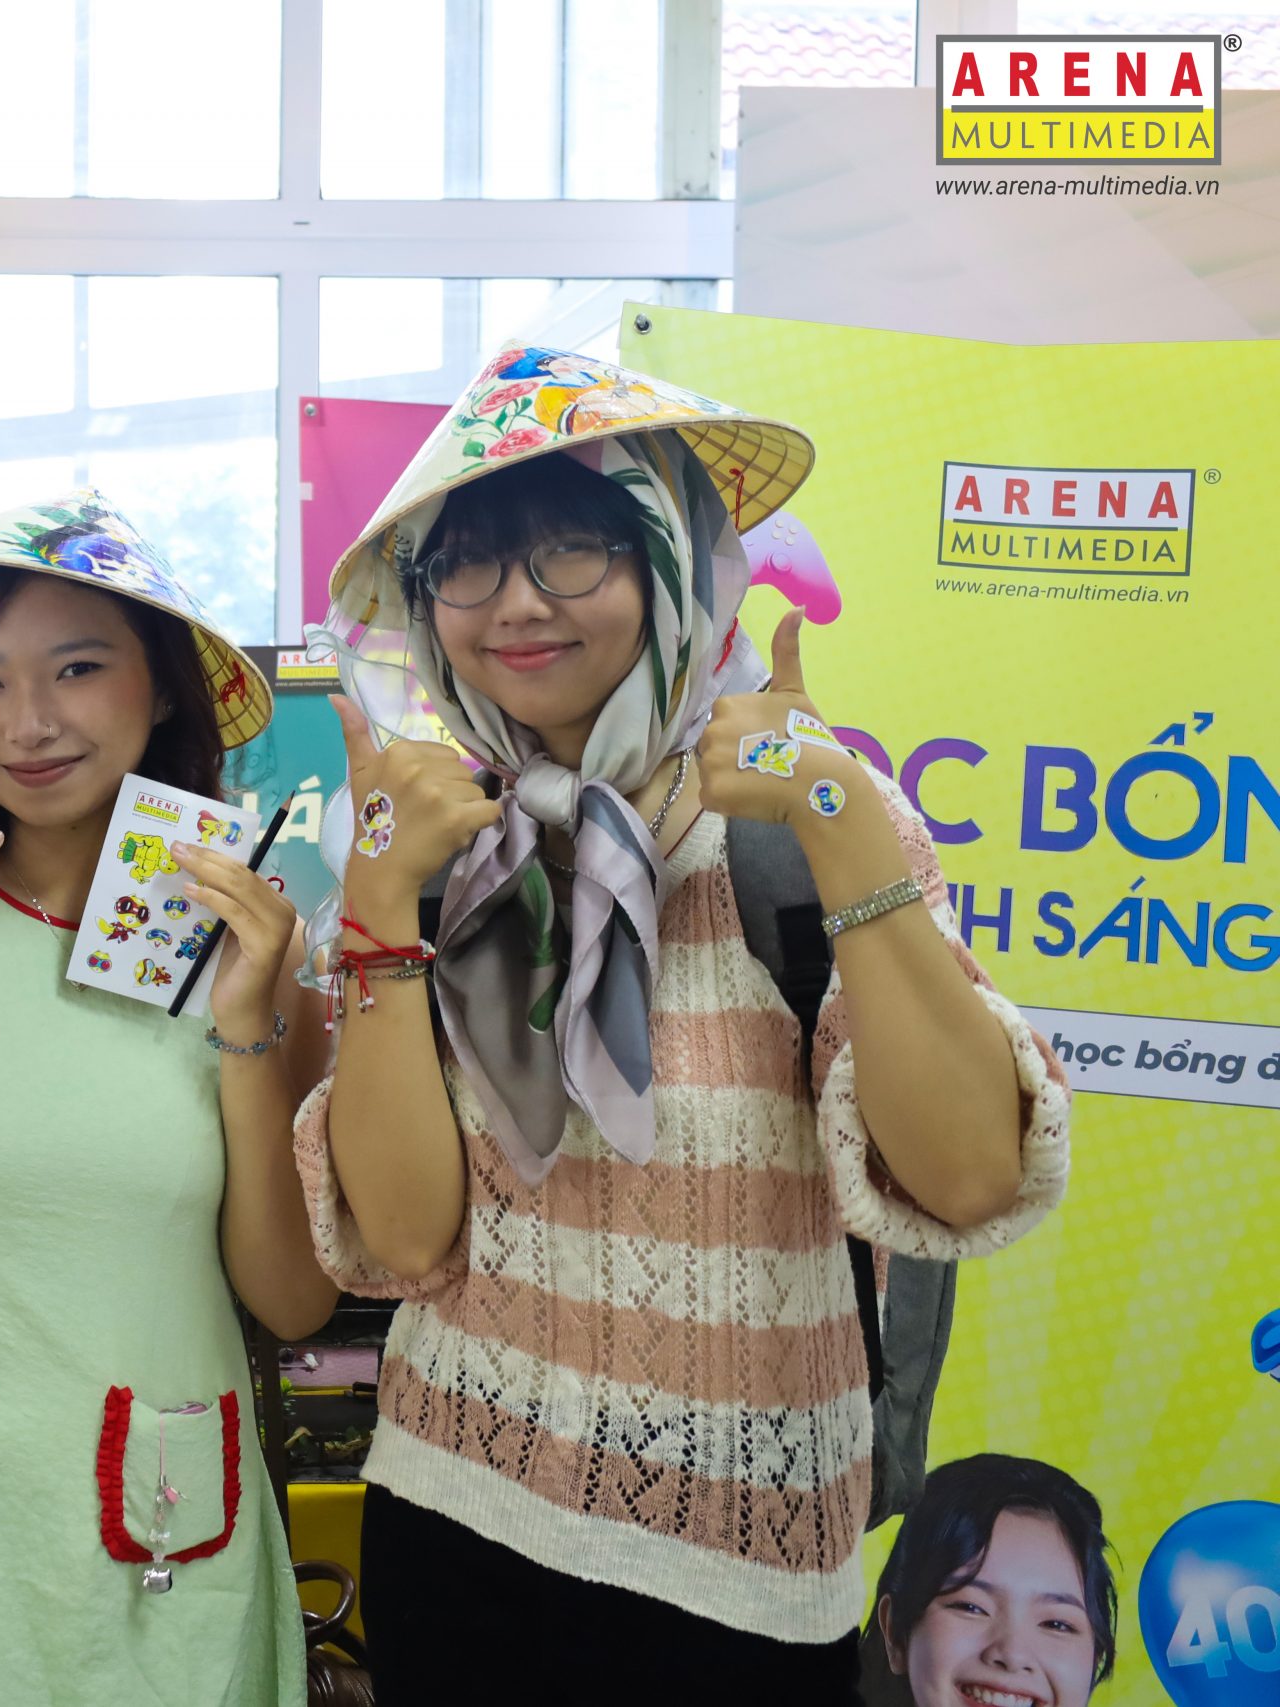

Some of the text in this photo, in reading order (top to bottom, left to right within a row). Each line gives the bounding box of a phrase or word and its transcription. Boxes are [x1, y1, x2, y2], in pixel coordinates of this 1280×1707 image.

[954, 475, 1179, 519] ARENA
[950, 531, 1177, 563] MULTIMEDIA
[935, 578, 1190, 603] www.arena-multimedia.vn
[139, 795, 179, 813] ARENA
[1033, 876, 1280, 971] SÁNG
[1050, 1033, 1126, 1073] học
[1135, 1039, 1247, 1084] bổng
